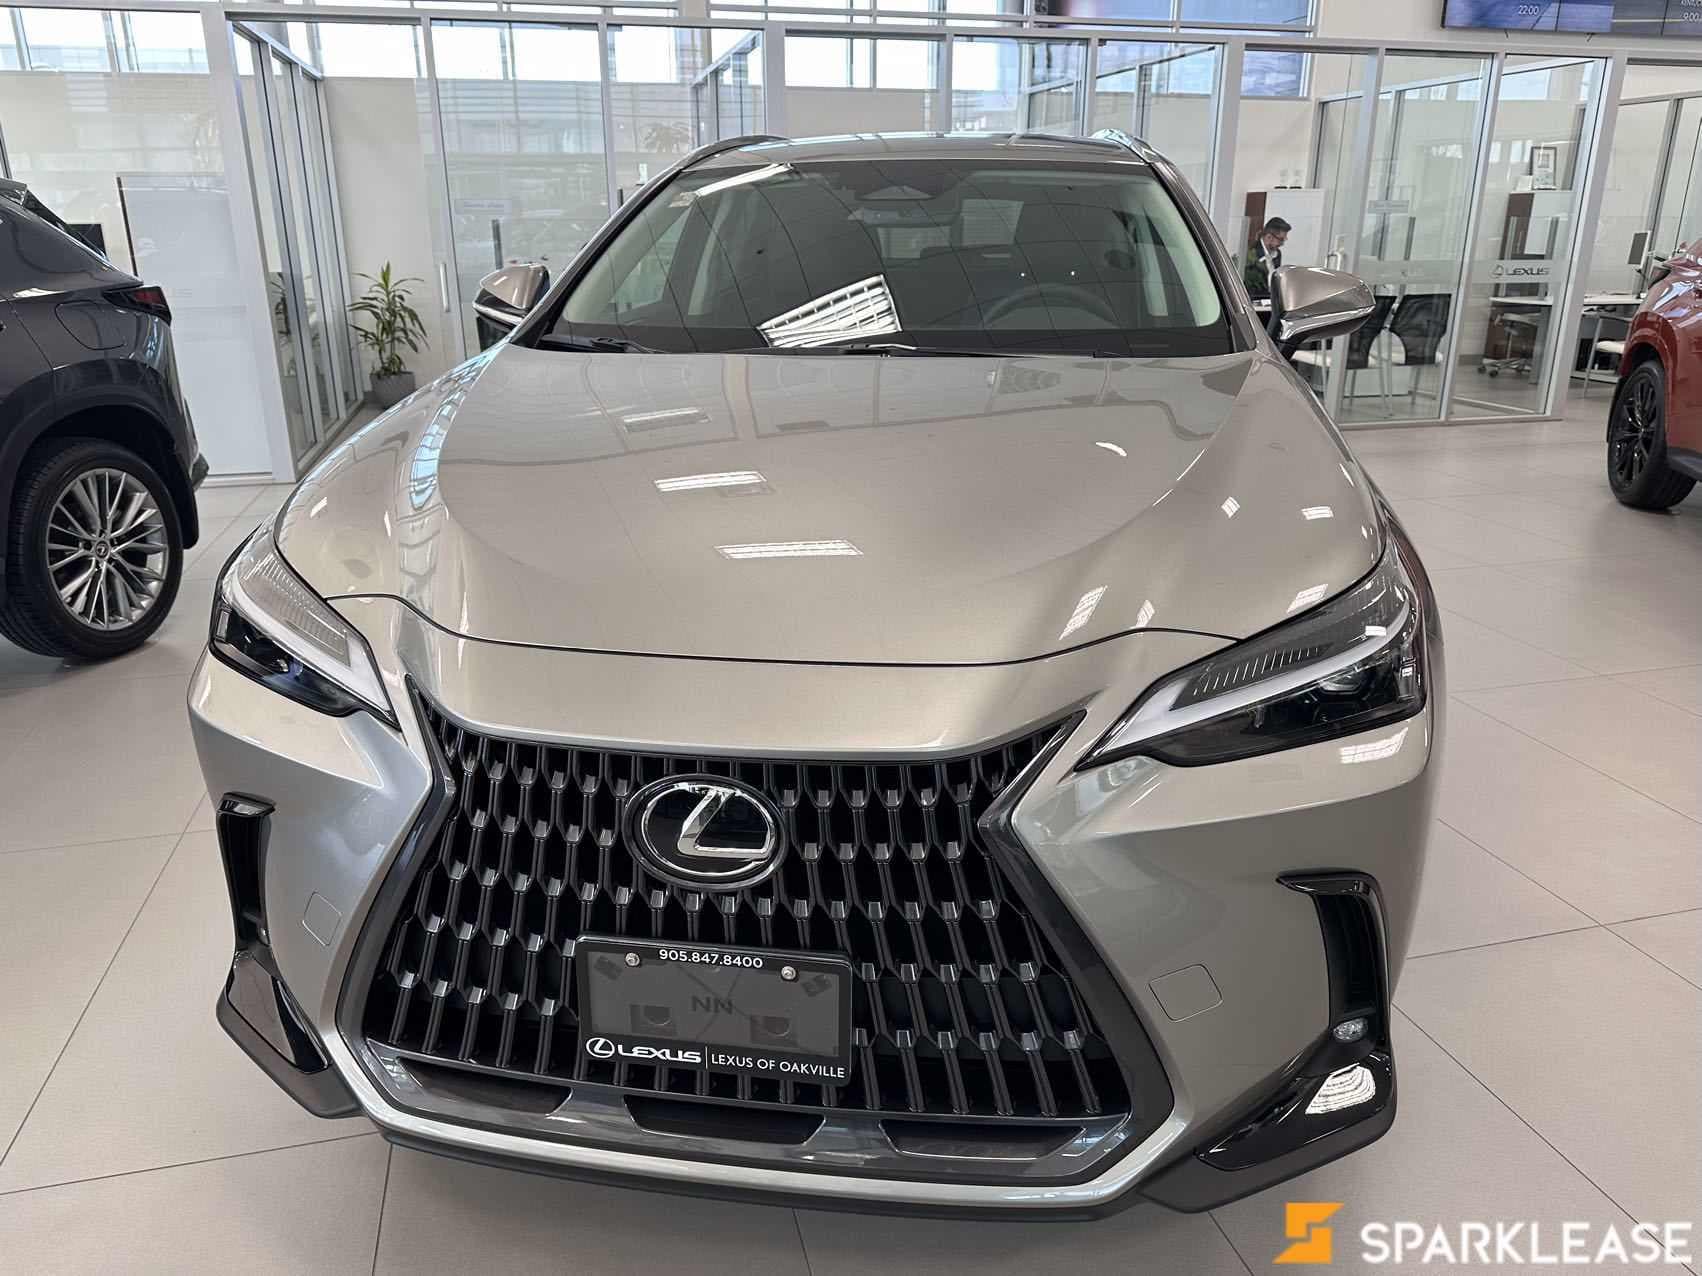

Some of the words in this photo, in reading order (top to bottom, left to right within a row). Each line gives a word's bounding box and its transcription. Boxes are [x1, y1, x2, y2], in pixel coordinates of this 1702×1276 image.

[1506, 267, 1551, 276] LEXUS
[659, 949, 764, 969] 905.847.8400
[618, 1044, 702, 1064] LEXUS
[711, 1053, 753, 1069] LEXUS
[758, 1057, 776, 1071] OF
[779, 1060, 845, 1079] OAKVILLE
